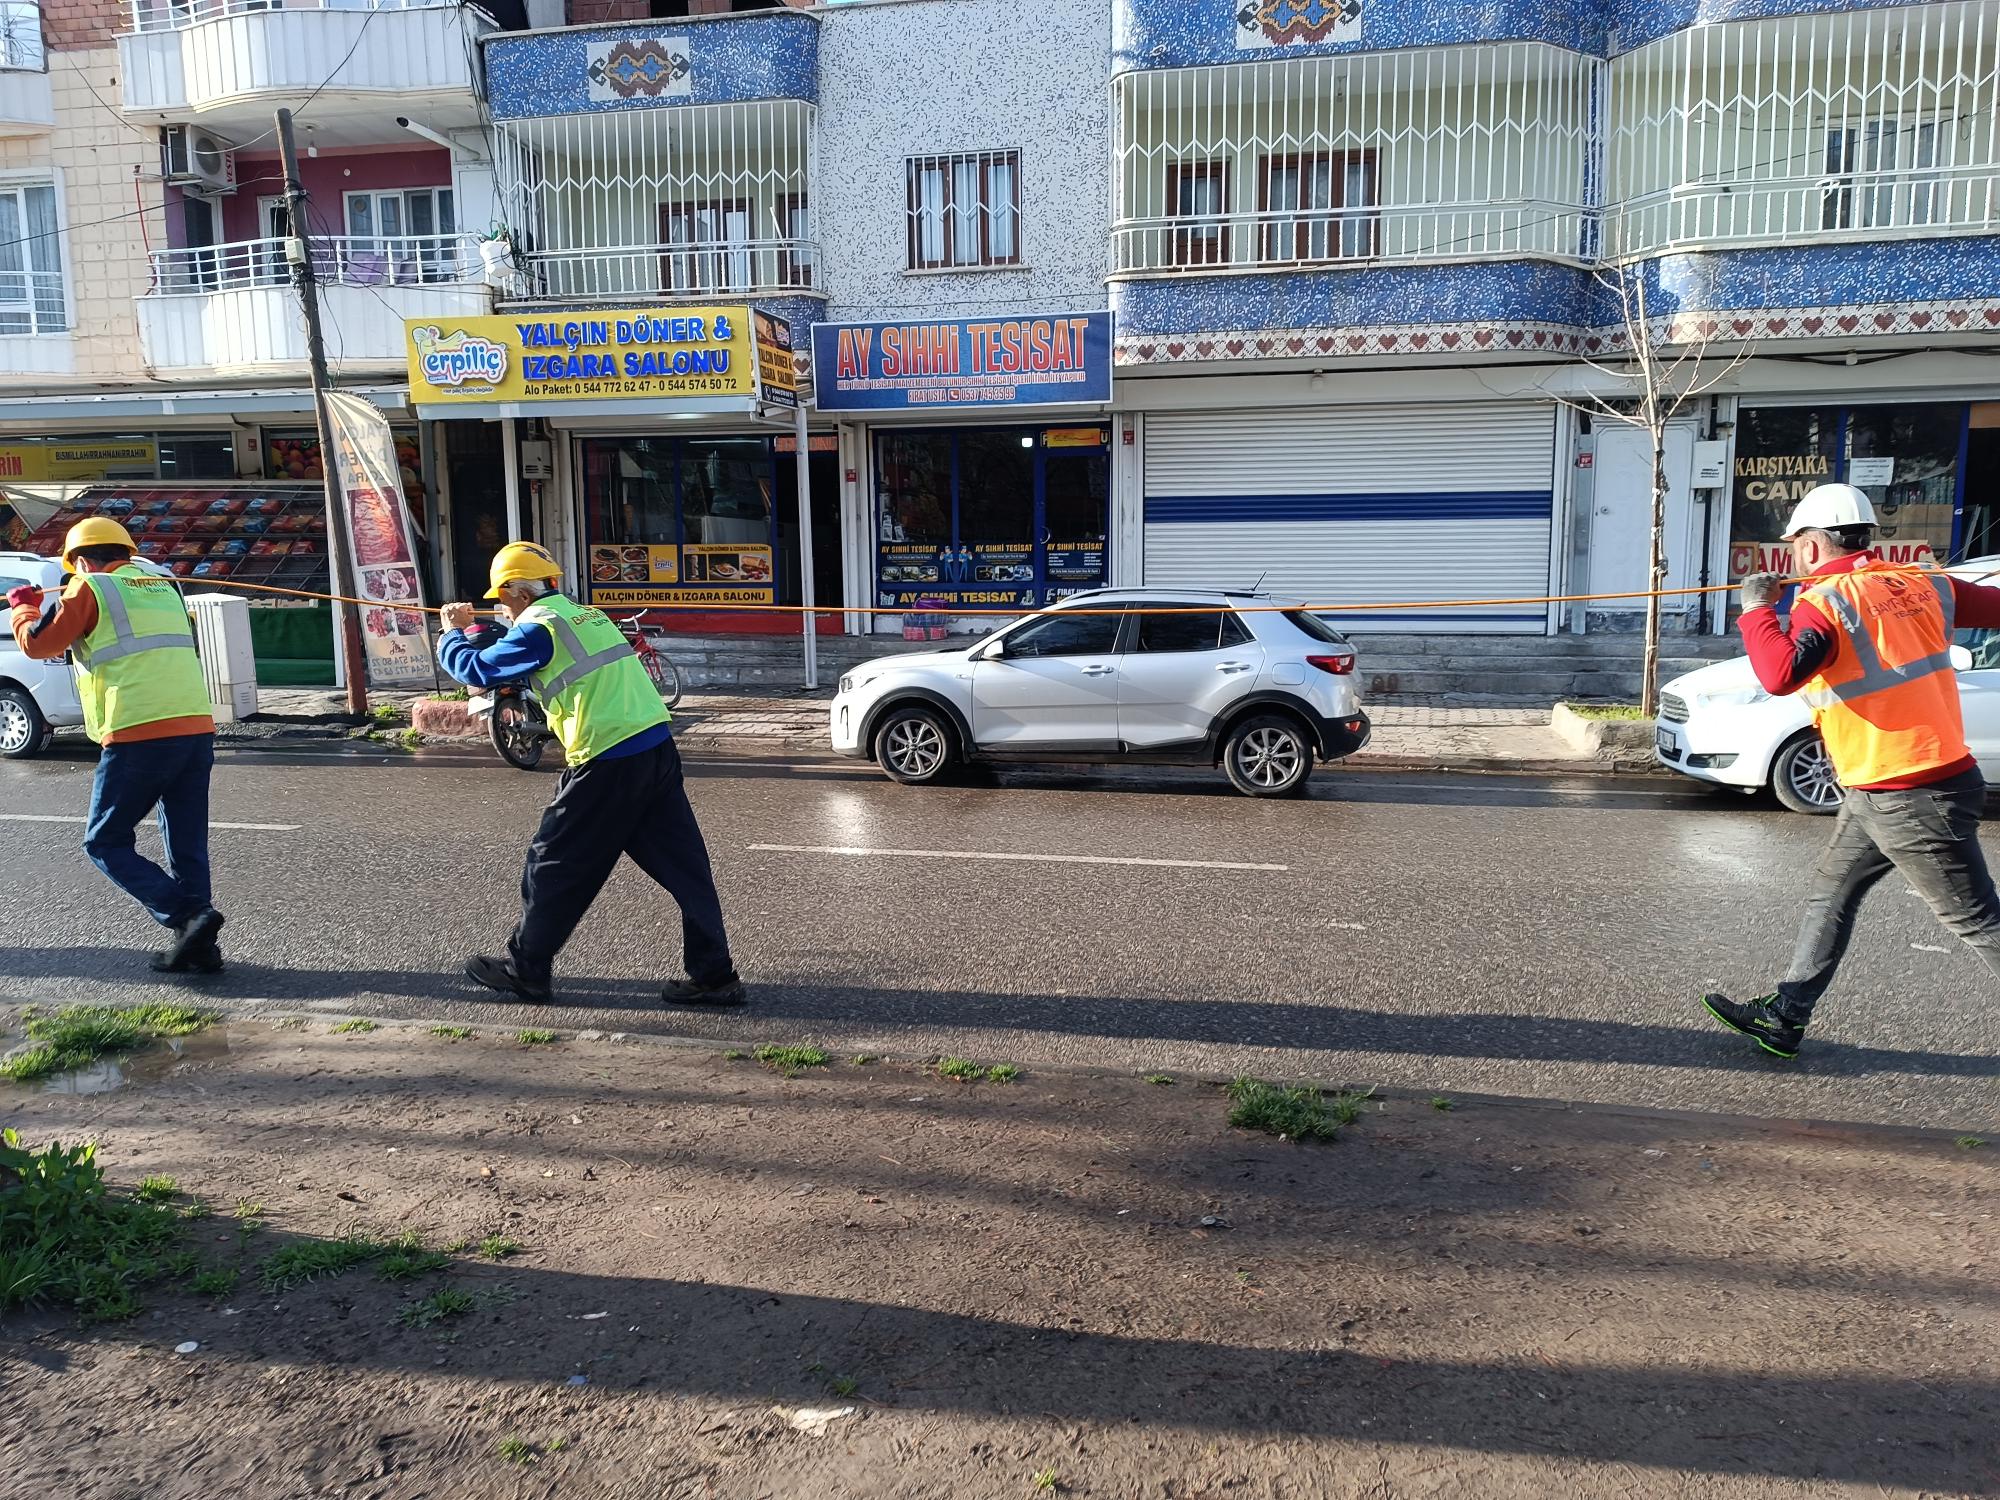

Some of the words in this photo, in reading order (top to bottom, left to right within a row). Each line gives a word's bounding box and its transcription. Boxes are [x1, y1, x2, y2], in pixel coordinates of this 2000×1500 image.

[516, 321, 608, 352] YALÇIN
[615, 314, 706, 344] DÖNER
[713, 315, 731, 340] &
[427, 346, 500, 376] erpiliç
[837, 328, 872, 378] AY
[522, 353, 618, 380] IZGARA
[624, 349, 729, 377] SALONU
[525, 385, 539, 395] Alo
[542, 384, 572, 394] Paket:
[575, 384, 580, 393] 0
[584, 383, 600, 393] 544
[604, 382, 621, 392] 772
[625, 381, 636, 391] 62
[639, 381, 650, 391] 47
[660, 380, 664, 390] 0
[668, 380, 685, 390] 544
[689, 379, 706, 390] 574
[710, 379, 721, 389] 50
[725, 379, 736, 389] 72
[908, 390, 927, 403] FIRAT
[928, 389, 947, 402] USTA
[961, 388, 979, 401] 0537
[1735, 455, 1828, 478] KARŞIYAKA
[1746, 481, 1817, 501] CAM
[881, 545, 889, 553] AY
[975, 544, 983, 553] AY
[599, 592, 636, 603] YALÇIN
[637, 590, 671, 600] DÖNER
[682, 592, 720, 600] IZGARA
[723, 592, 765, 600] SALONU
[900, 592, 917, 603] AY
